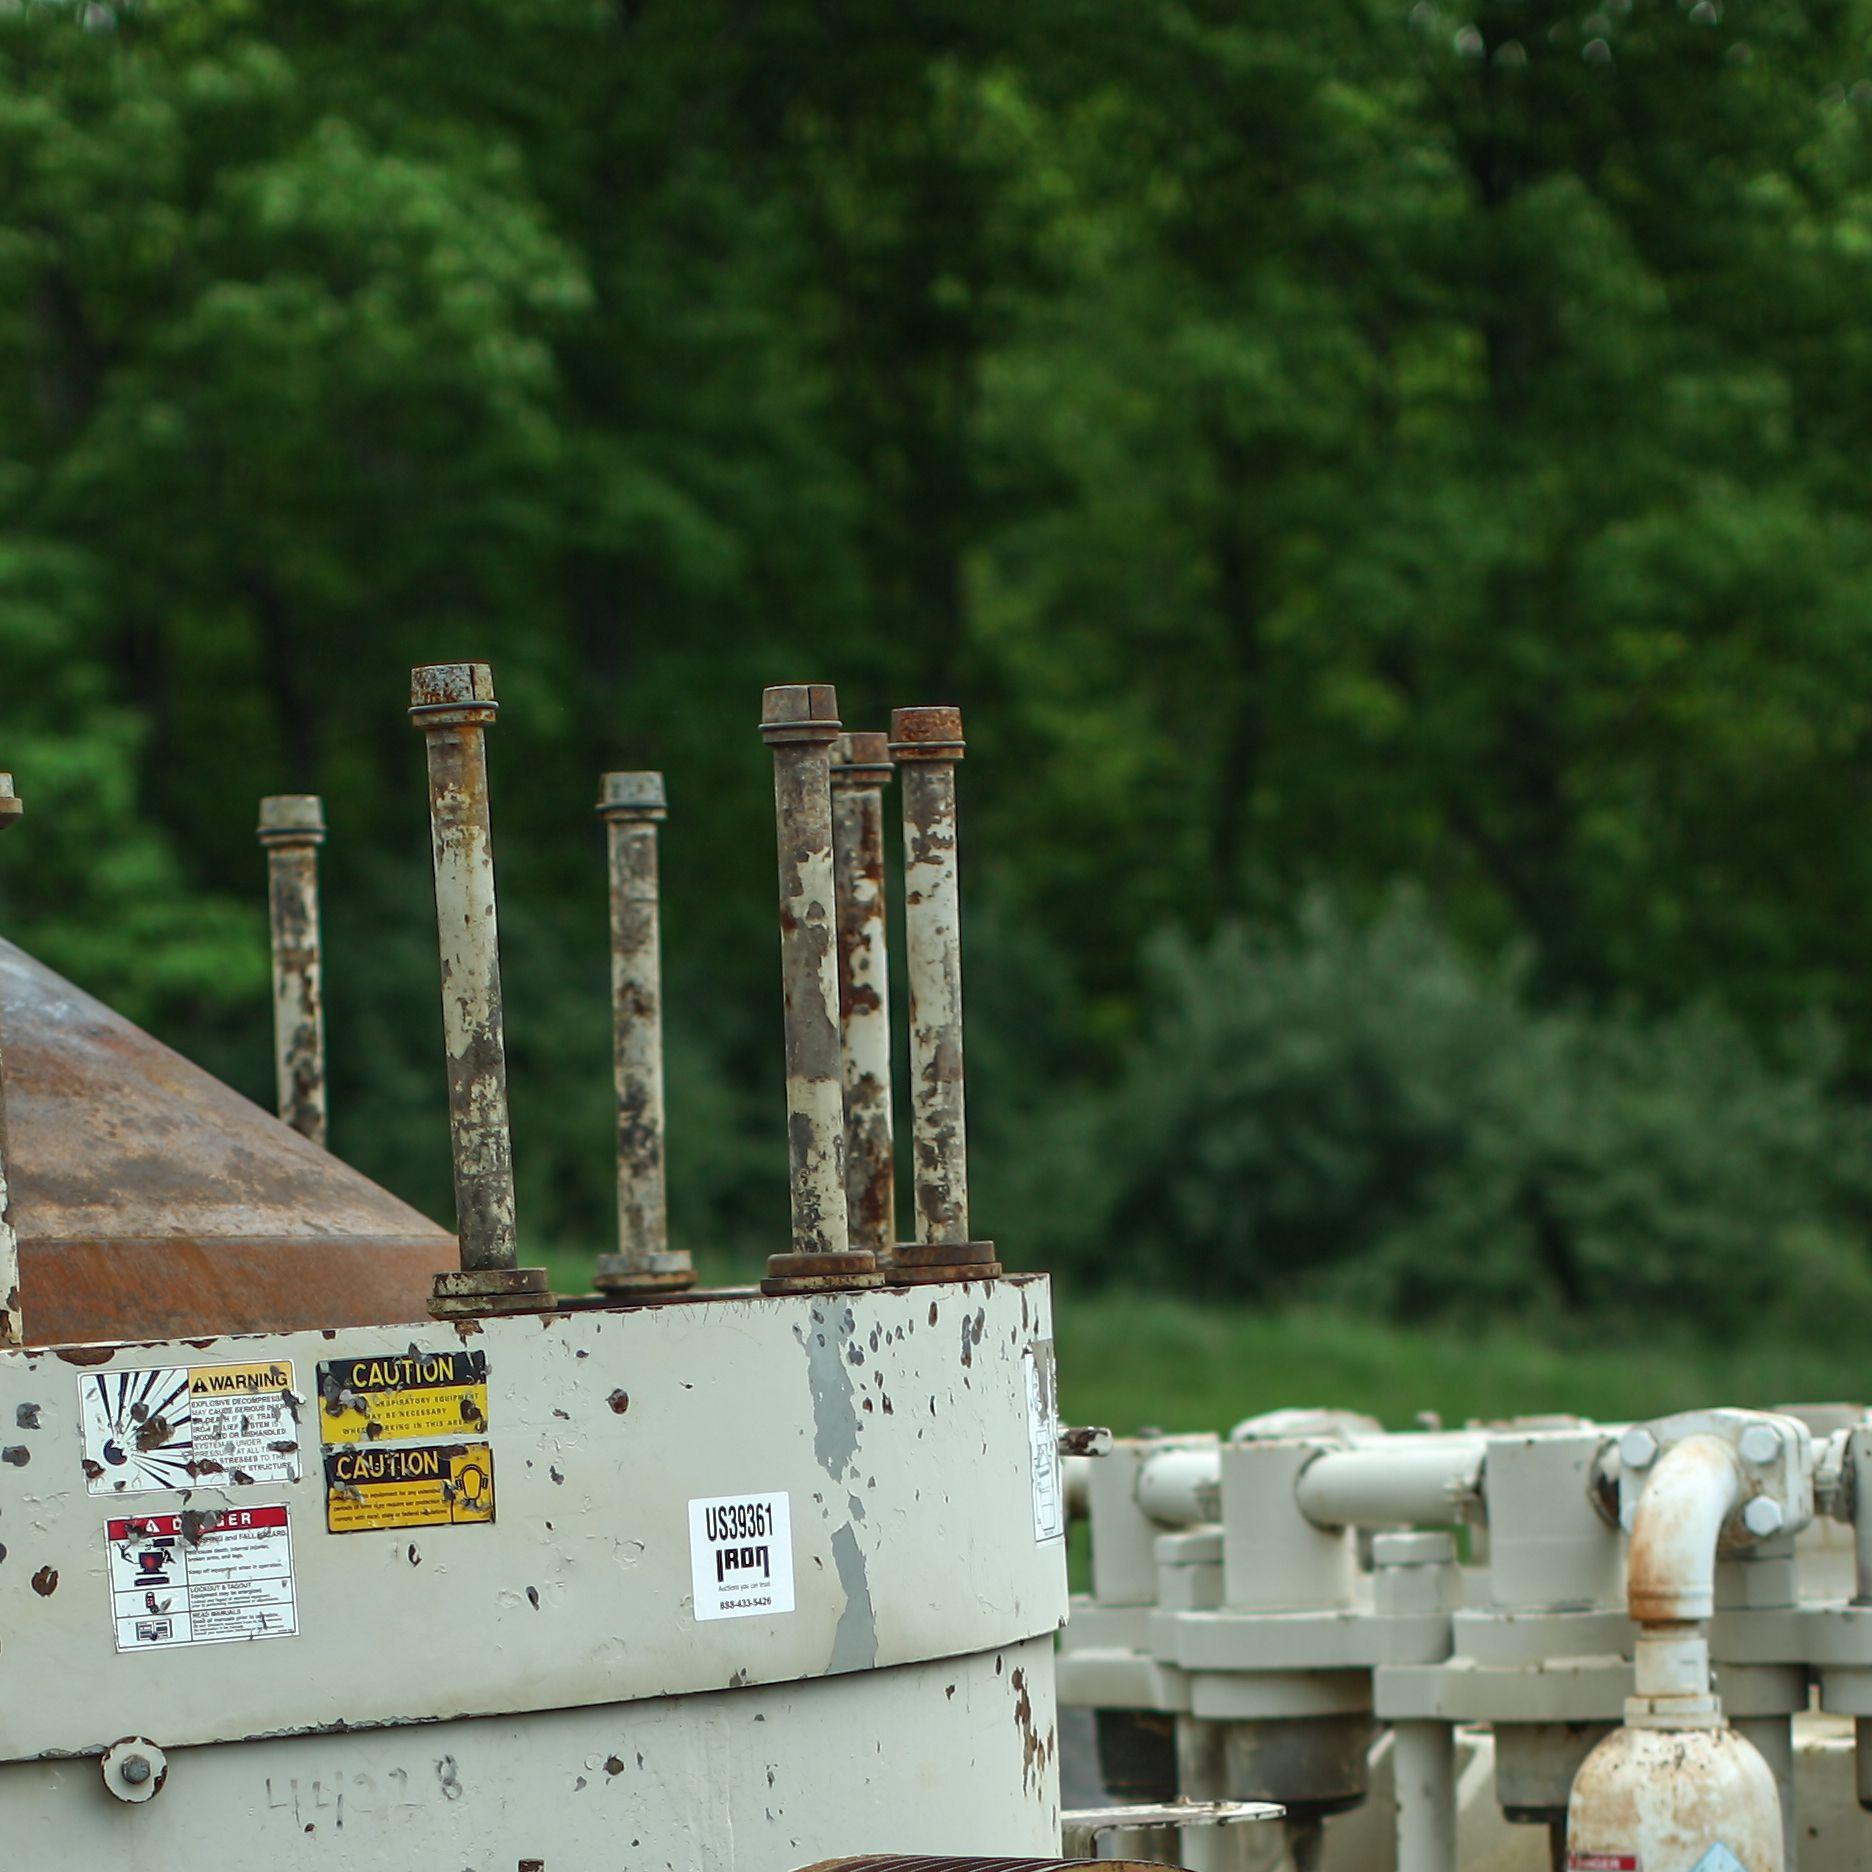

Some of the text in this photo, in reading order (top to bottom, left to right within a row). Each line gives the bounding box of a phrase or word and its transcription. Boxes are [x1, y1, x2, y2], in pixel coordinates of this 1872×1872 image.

[208, 1372, 288, 1391] WARNING
[352, 1356, 454, 1388] CAUTION
[191, 1399, 231, 1408] EXPLOSIVE
[398, 1407, 447, 1417] NECESSARY
[426, 1420, 444, 1428] THIS
[337, 1450, 439, 1480] CAUTION
[173, 1511, 251, 1531] DGER
[705, 1502, 773, 1542] US39361
